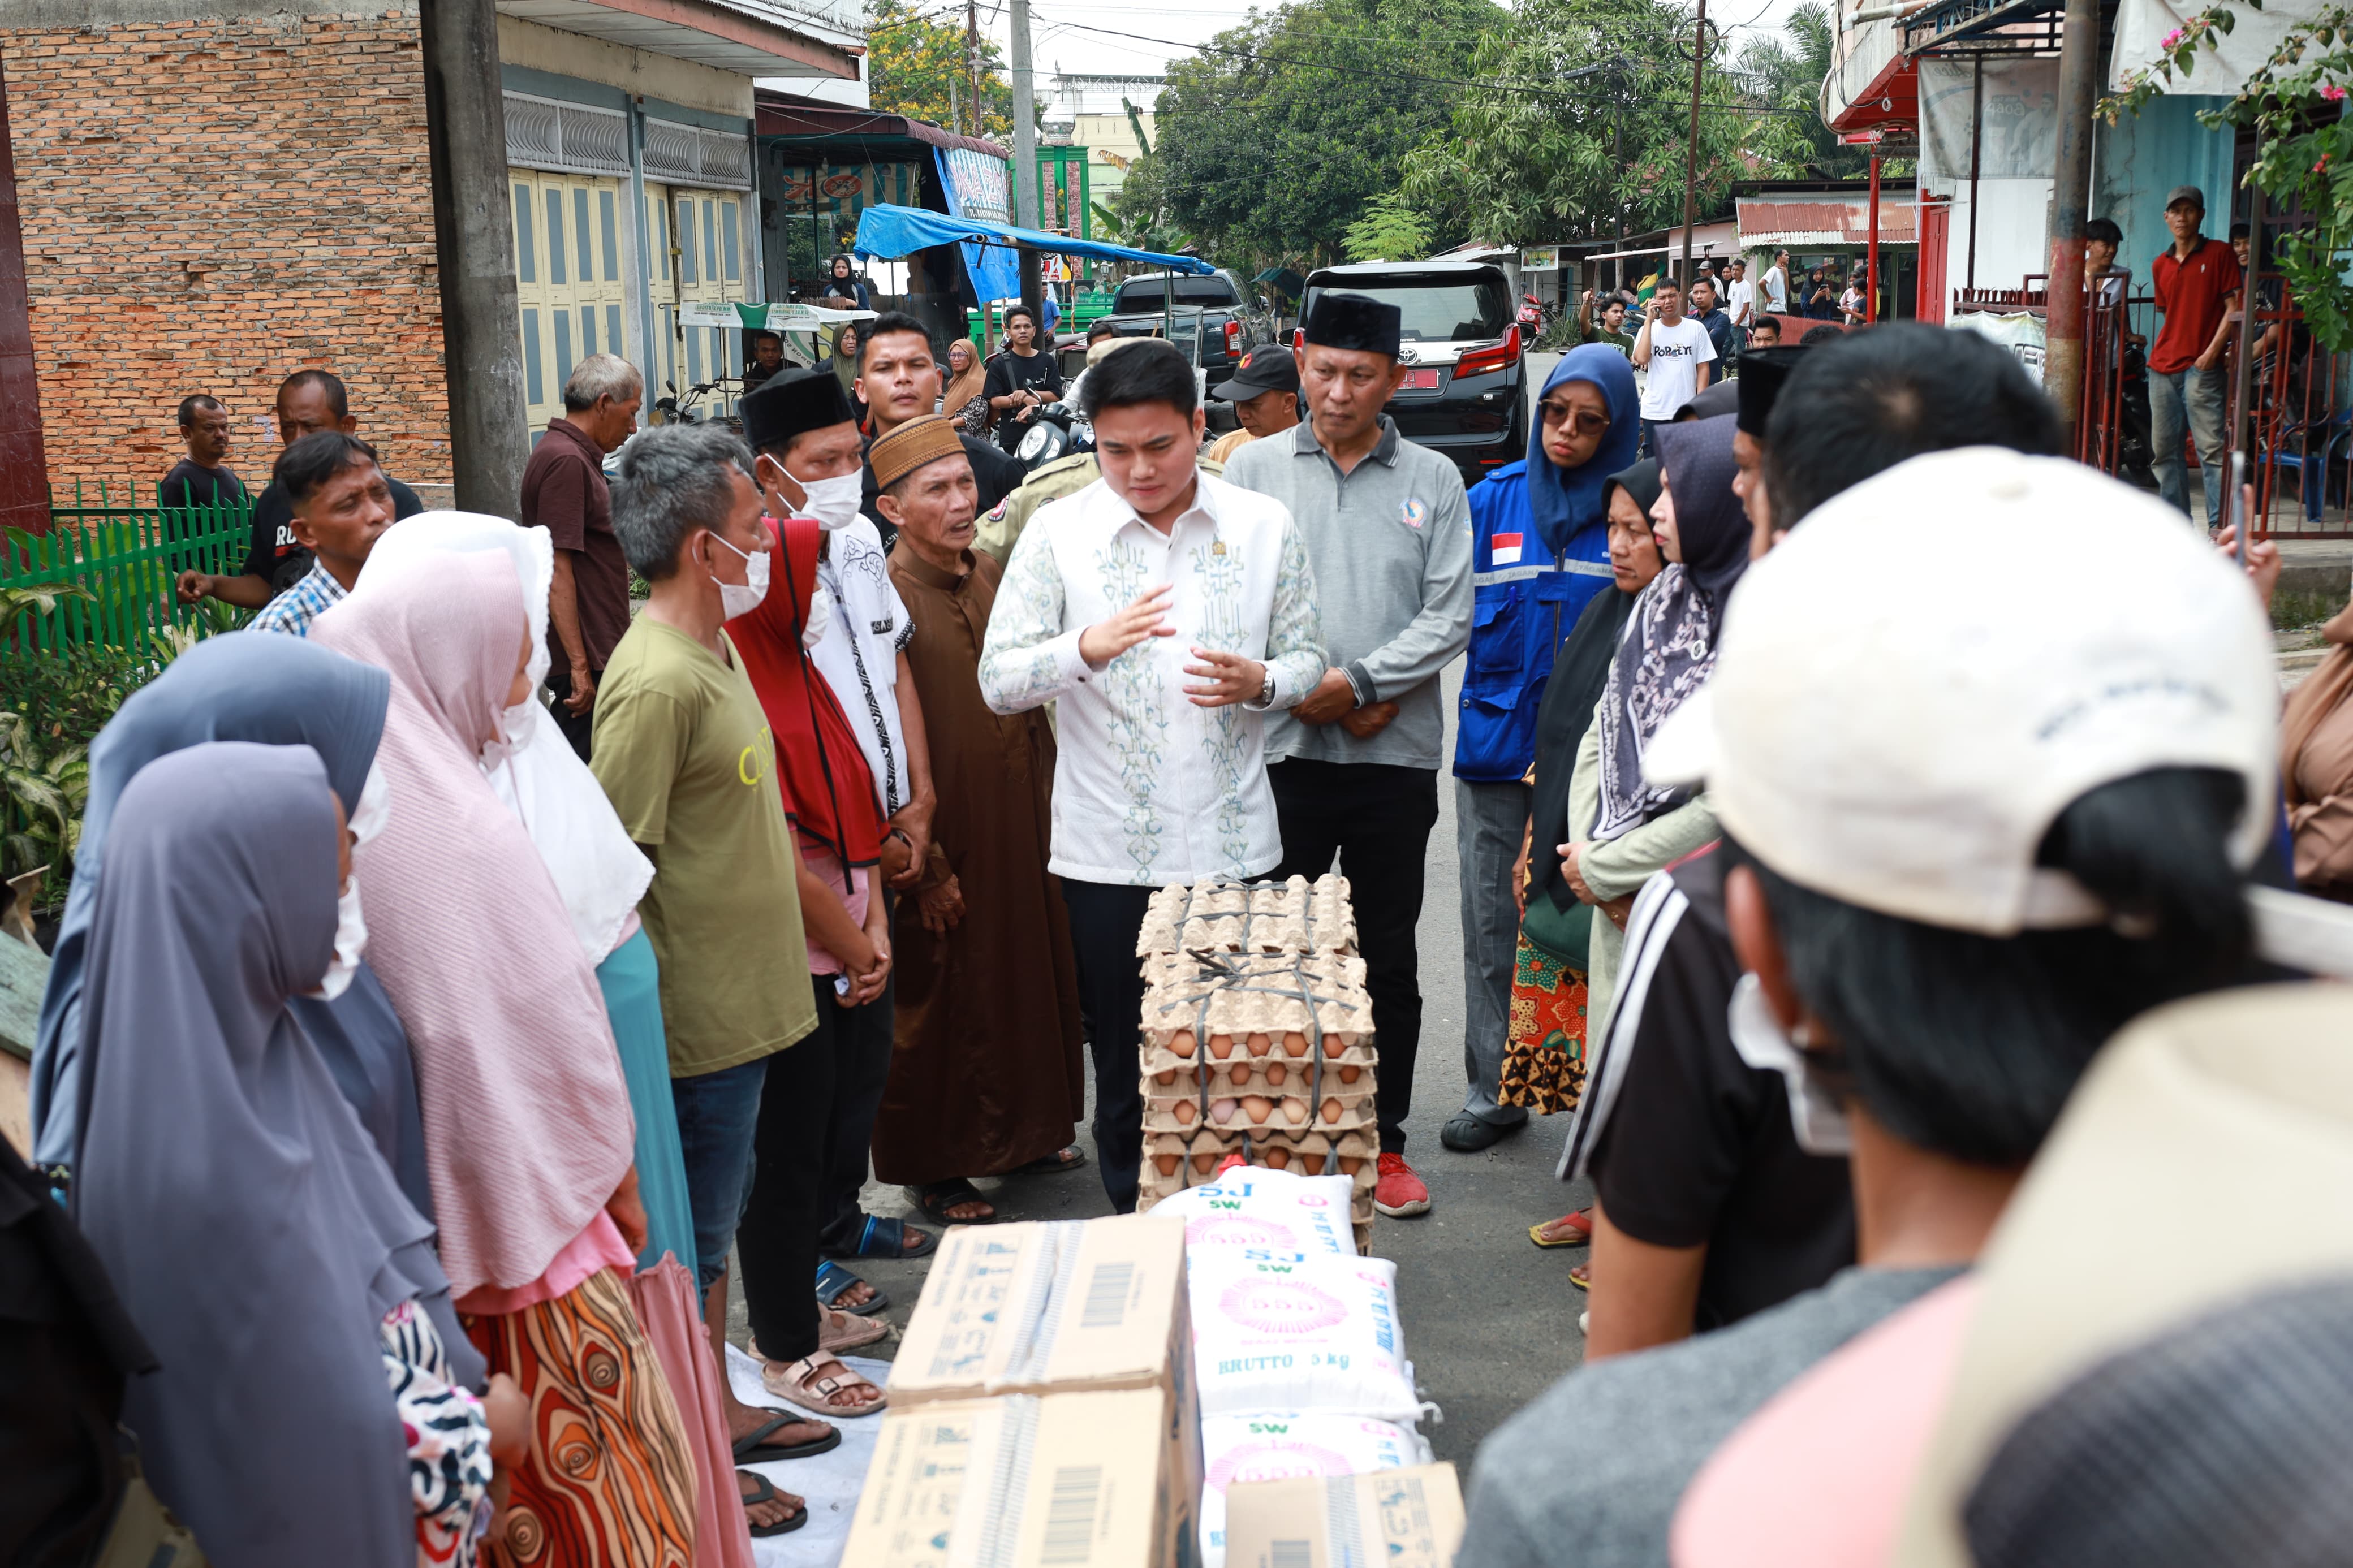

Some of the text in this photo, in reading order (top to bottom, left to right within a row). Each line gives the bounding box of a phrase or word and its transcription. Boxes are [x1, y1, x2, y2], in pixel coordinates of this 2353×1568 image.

[1198, 1182, 1254, 1198] SJ
[1209, 1200, 1242, 1210] SW
[1245, 1249, 1305, 1263] SJ
[1257, 1264, 1292, 1273] SW
[1218, 1352, 1350, 1375] BRUTTO 5 kg
[1248, 1423, 1289, 1434] SW
